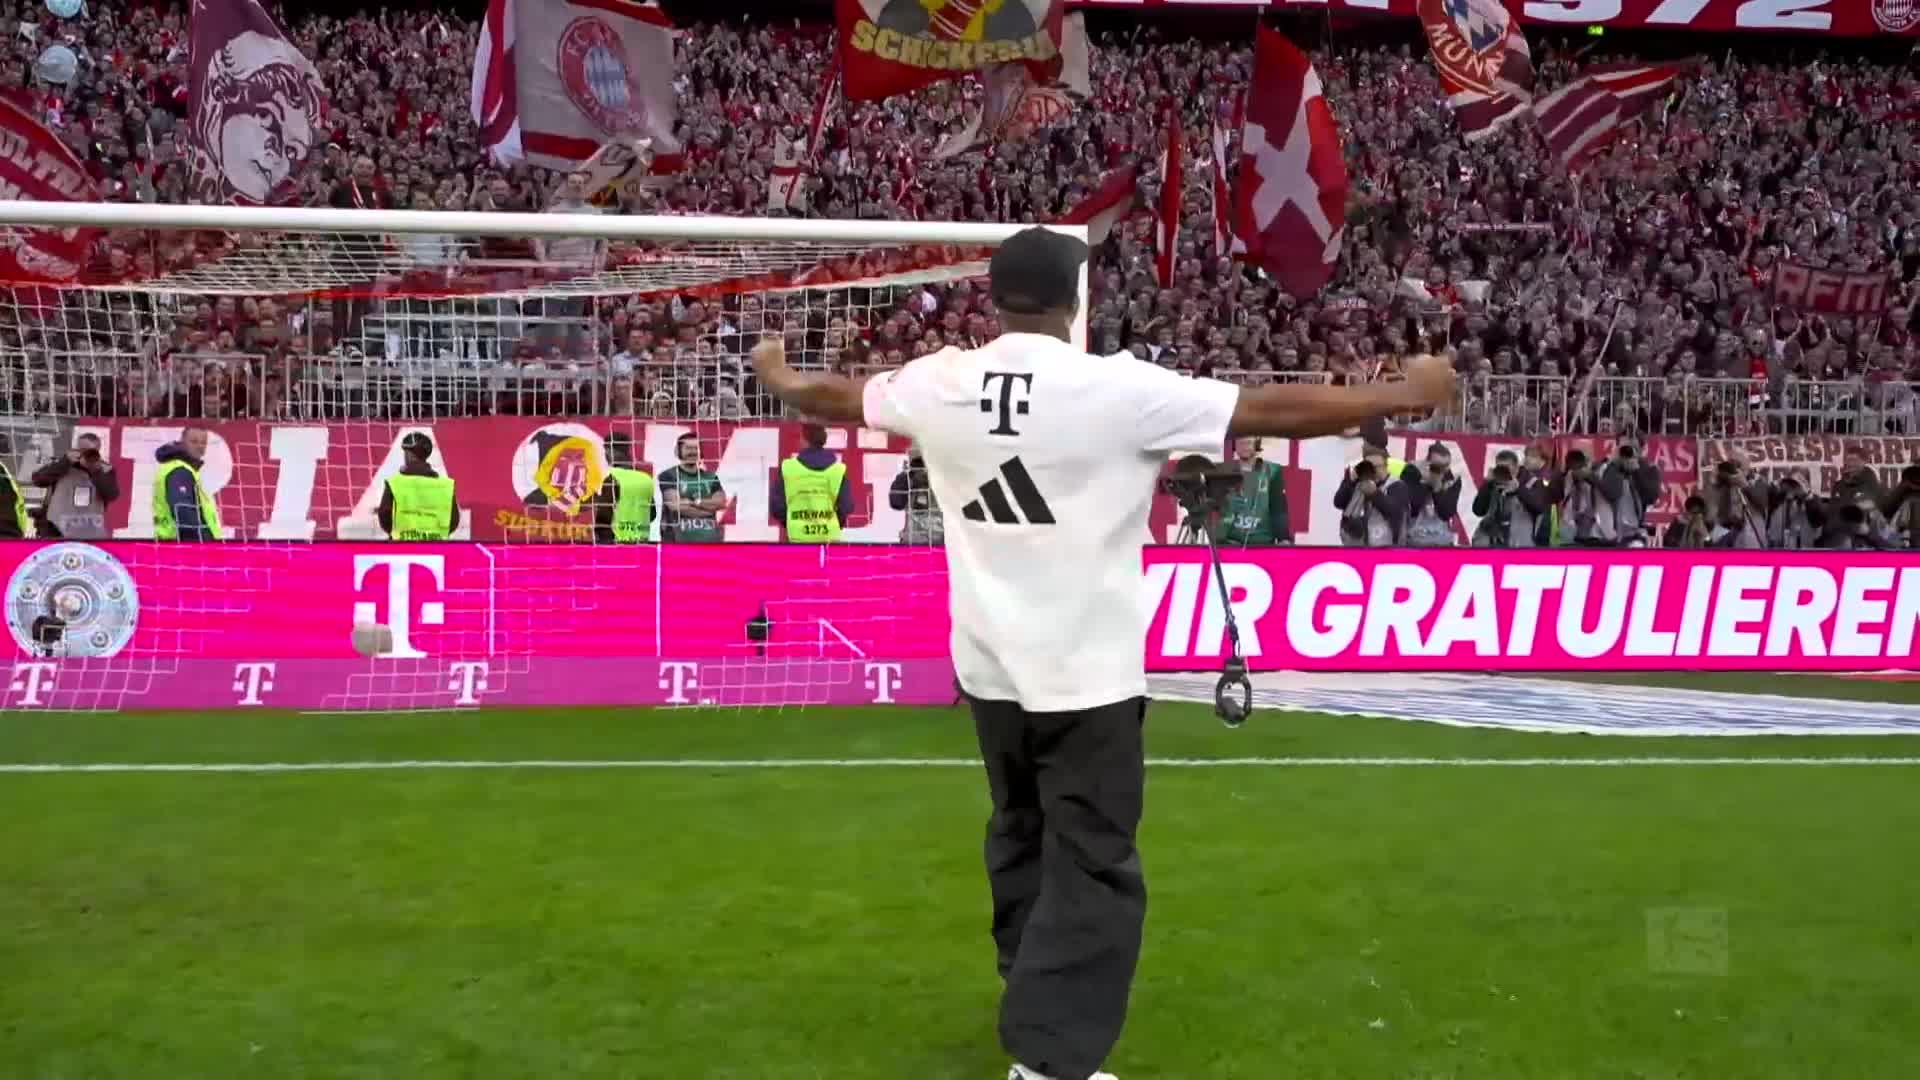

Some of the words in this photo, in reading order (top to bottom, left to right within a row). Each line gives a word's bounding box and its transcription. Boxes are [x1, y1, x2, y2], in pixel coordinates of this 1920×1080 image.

[981, 372, 1032, 436] T
[354, 555, 445, 658] T
[12, 662, 57, 705] T
[233, 662, 276, 705] T
[448, 662, 489, 705] T
[658, 662, 698, 703] T
[864, 662, 902, 704] T
